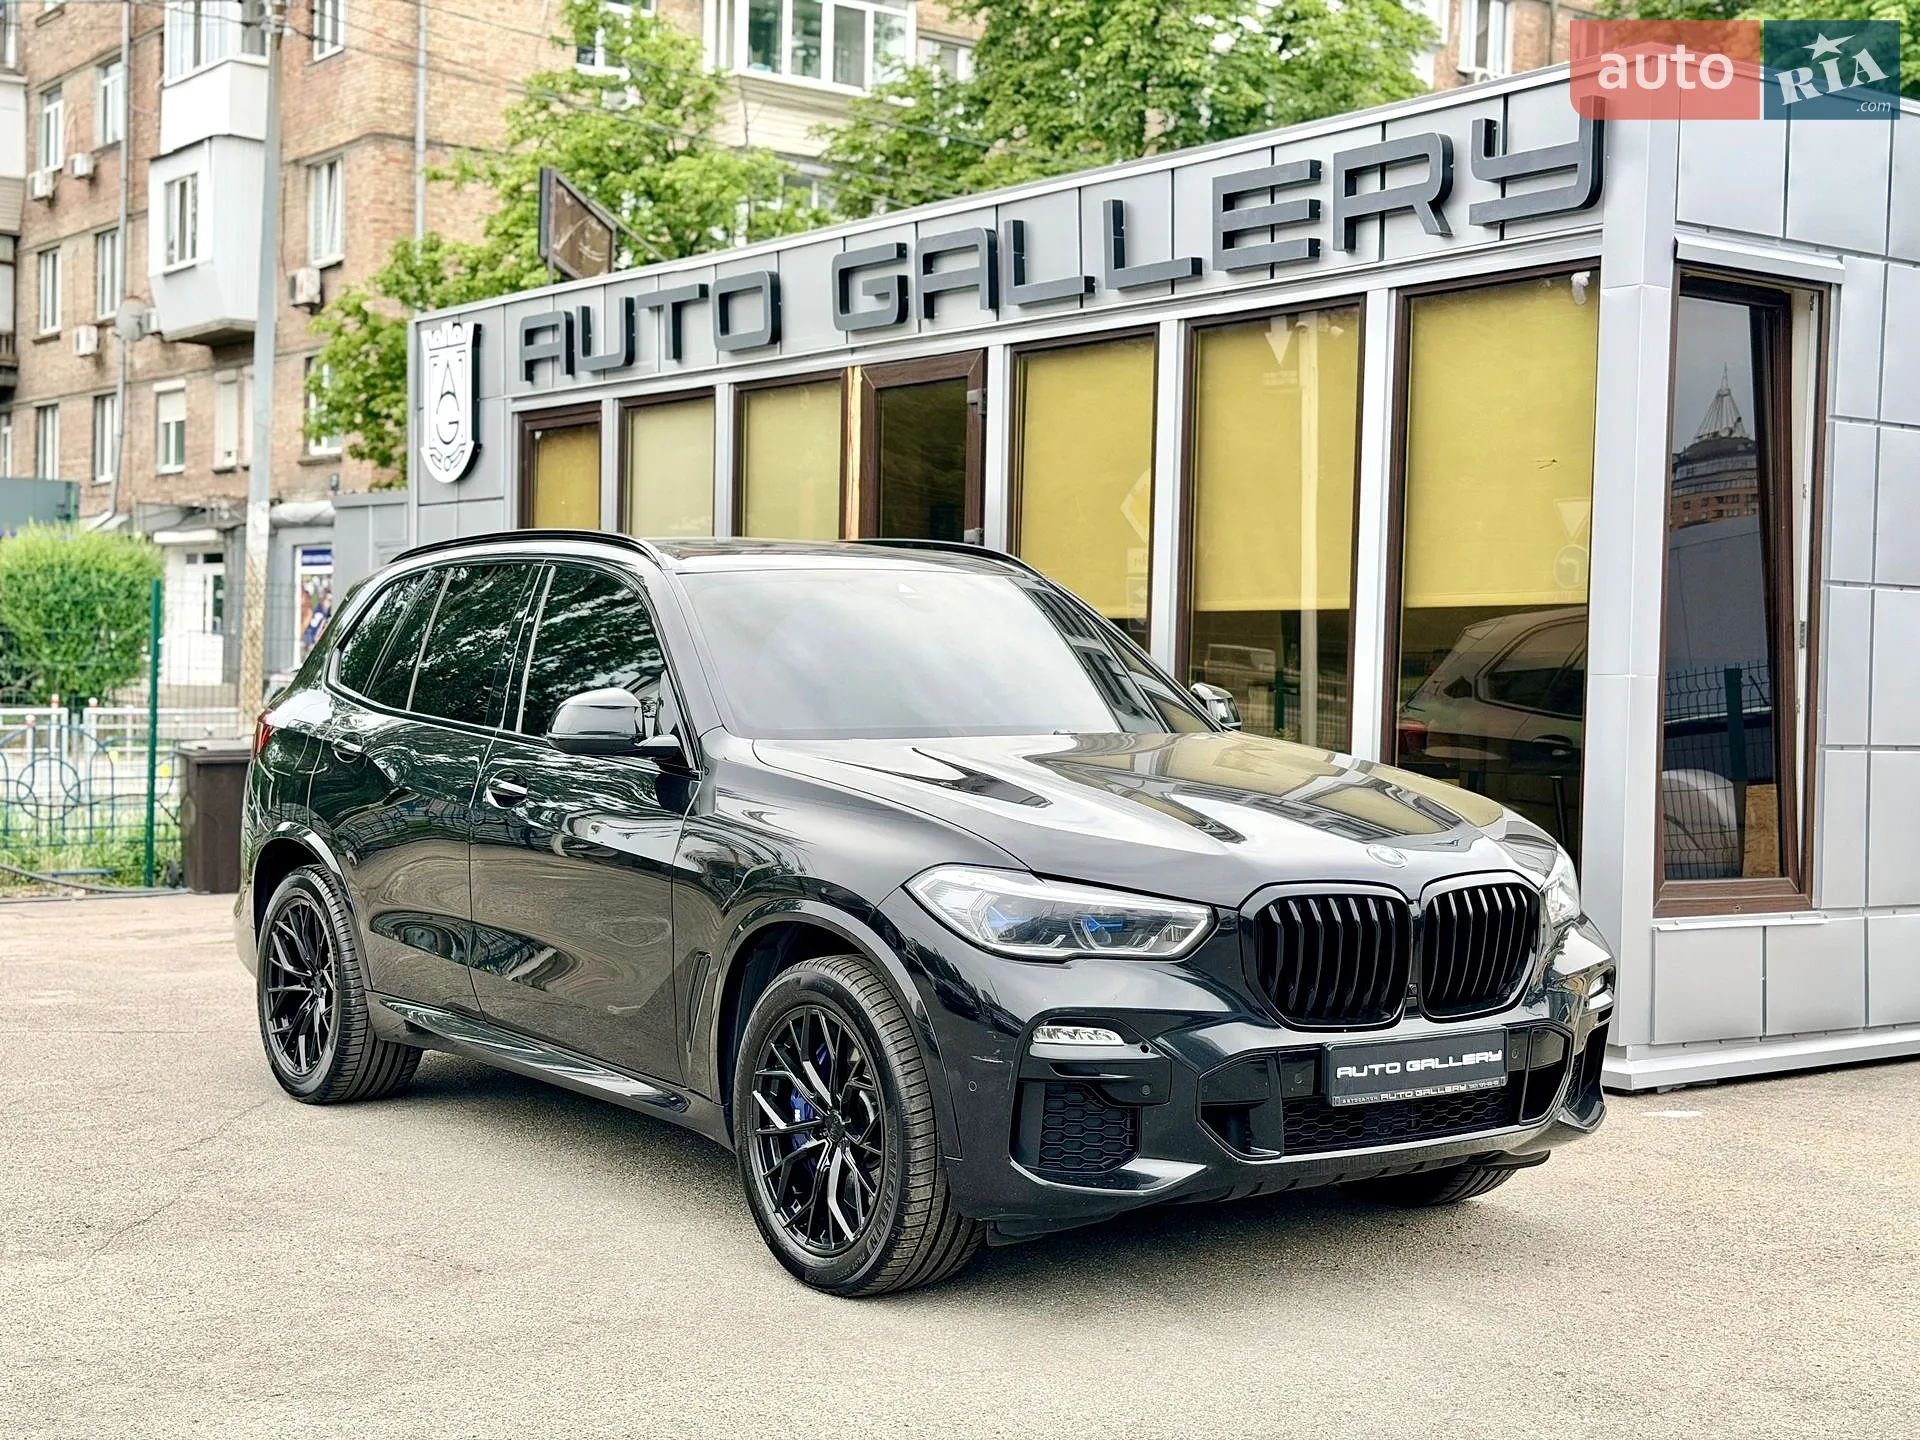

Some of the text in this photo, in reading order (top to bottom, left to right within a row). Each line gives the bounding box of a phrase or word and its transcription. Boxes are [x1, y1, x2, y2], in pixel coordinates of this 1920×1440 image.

[520, 95, 1606, 384] AUTO GALLERY
[1336, 1050, 1502, 1078] AUTO GALLERY
[1380, 1091, 1413, 1101] AUTO
[1415, 1083, 1467, 1097] GALLERY
